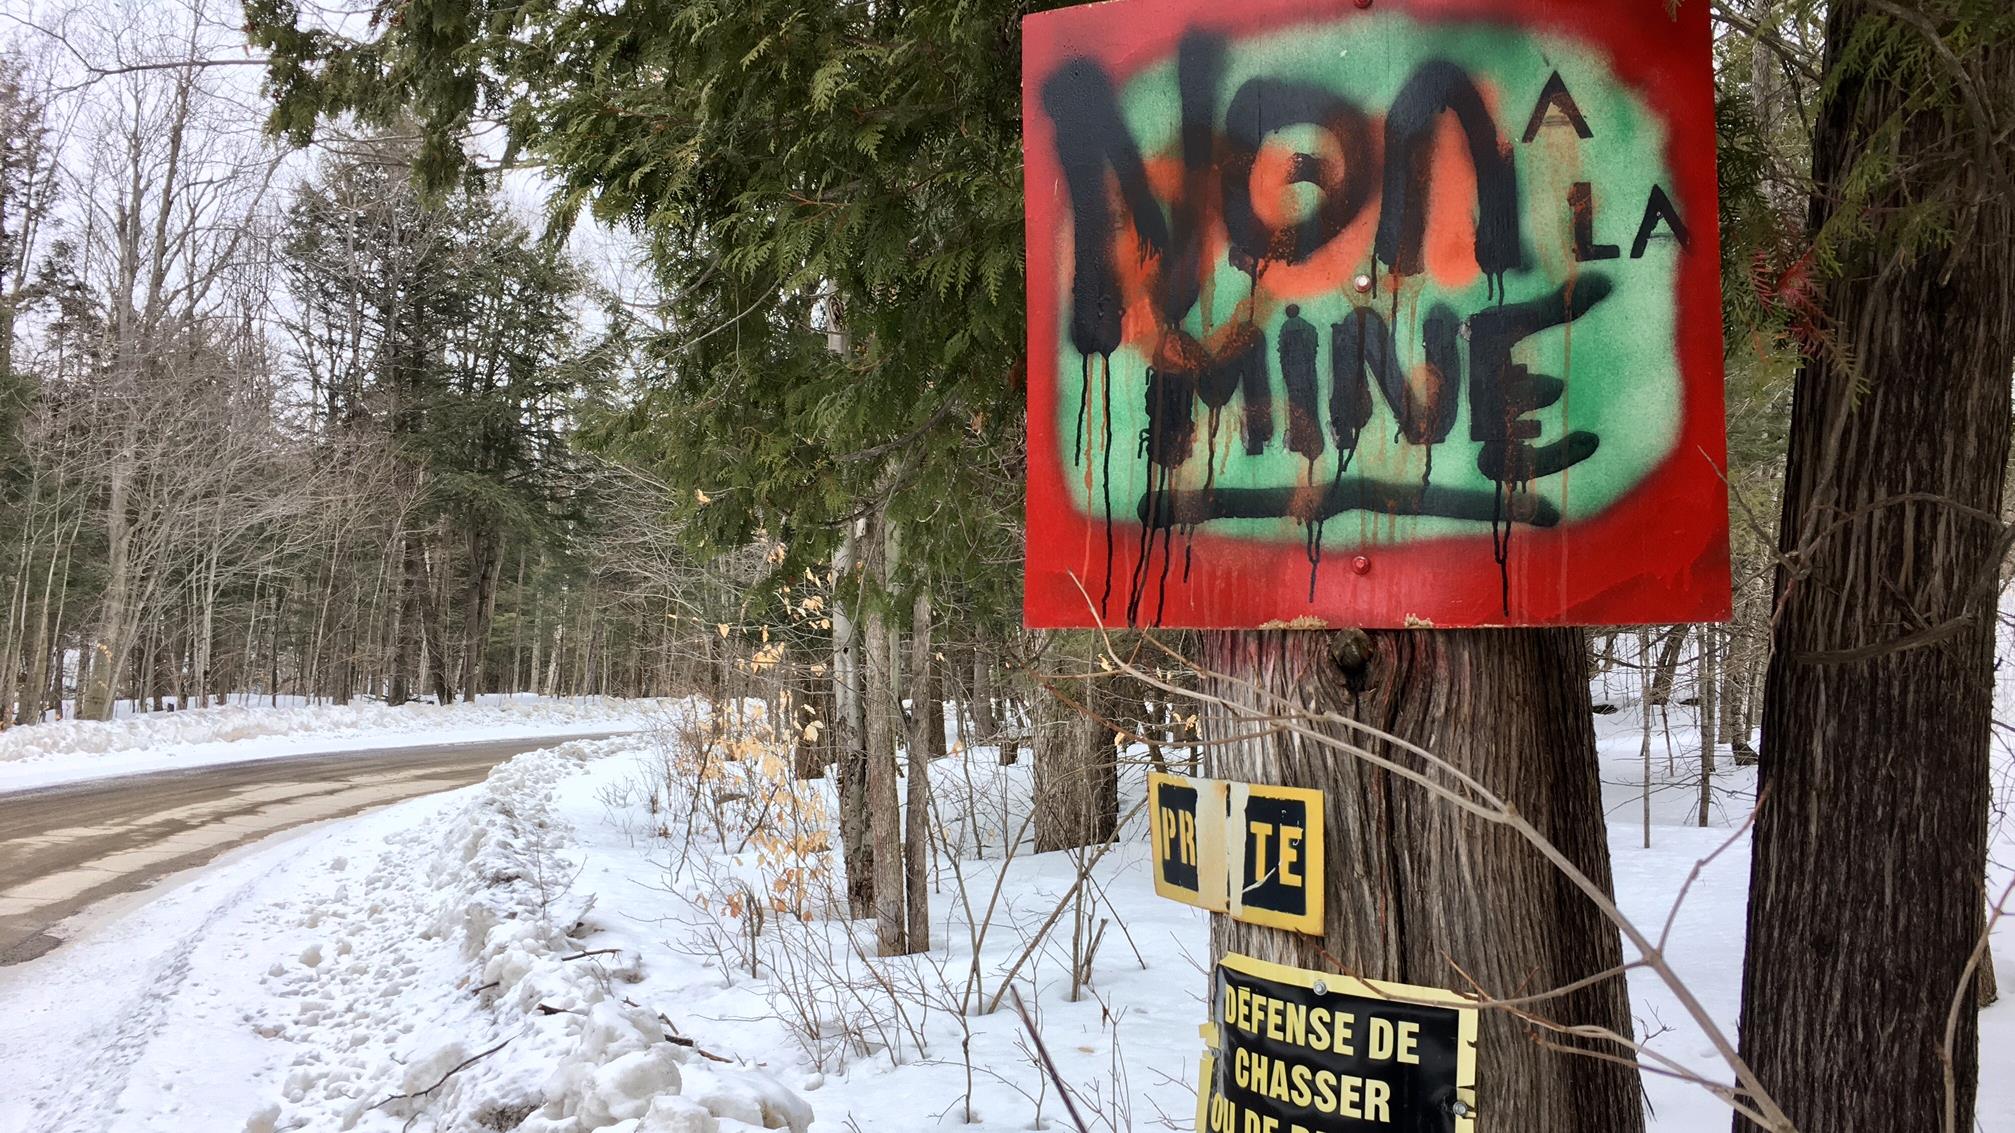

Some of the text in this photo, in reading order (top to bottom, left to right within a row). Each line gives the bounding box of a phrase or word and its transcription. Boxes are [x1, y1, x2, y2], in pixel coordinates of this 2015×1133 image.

[1567, 181, 1693, 262] LA
[1143, 271, 1613, 483] MINE
[1160, 806, 1304, 888] PRTE
[1368, 1016, 1420, 1065] DE
[1211, 1091, 1236, 1133] OU
[1234, 1046, 1391, 1123] CHASSER
